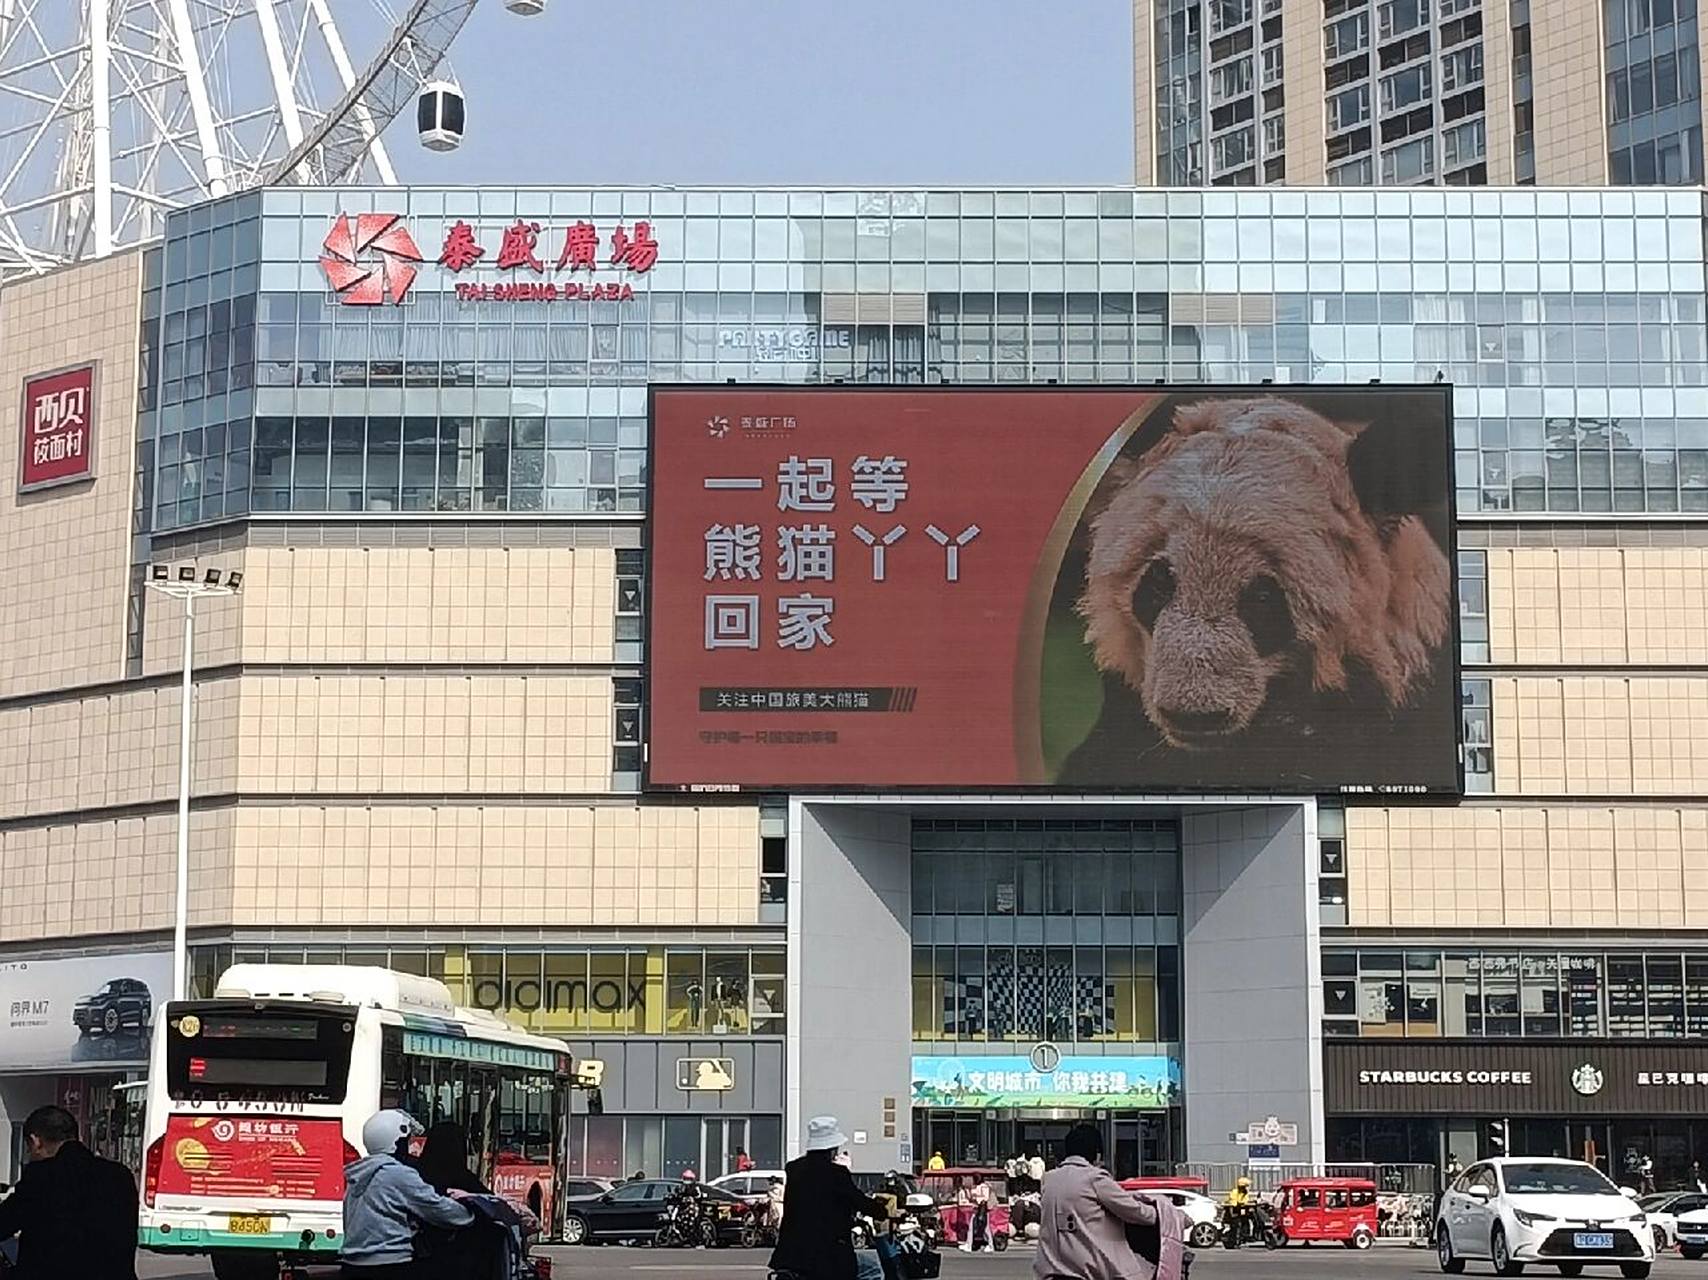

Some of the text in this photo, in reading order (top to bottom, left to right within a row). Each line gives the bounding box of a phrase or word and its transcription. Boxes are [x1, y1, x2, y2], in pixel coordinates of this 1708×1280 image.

[438, 219, 658, 273] 泰盛廣場
[455, 283, 633, 301] TAI SHENG PLAZA
[34, 387, 85, 434] 西贝
[704, 456, 909, 512] 一起等
[704, 523, 981, 582] 熊猫丫丫
[704, 593, 835, 650] 回家
[717, 692, 869, 708] 关注中国旅美大熊猫
[0, 963, 28, 972] ITO
[33, 1000, 49, 1014] M7
[968, 1071, 1041, 1092] 文明城市
[1359, 1071, 1532, 1084] STARBUCKS COFFEE
